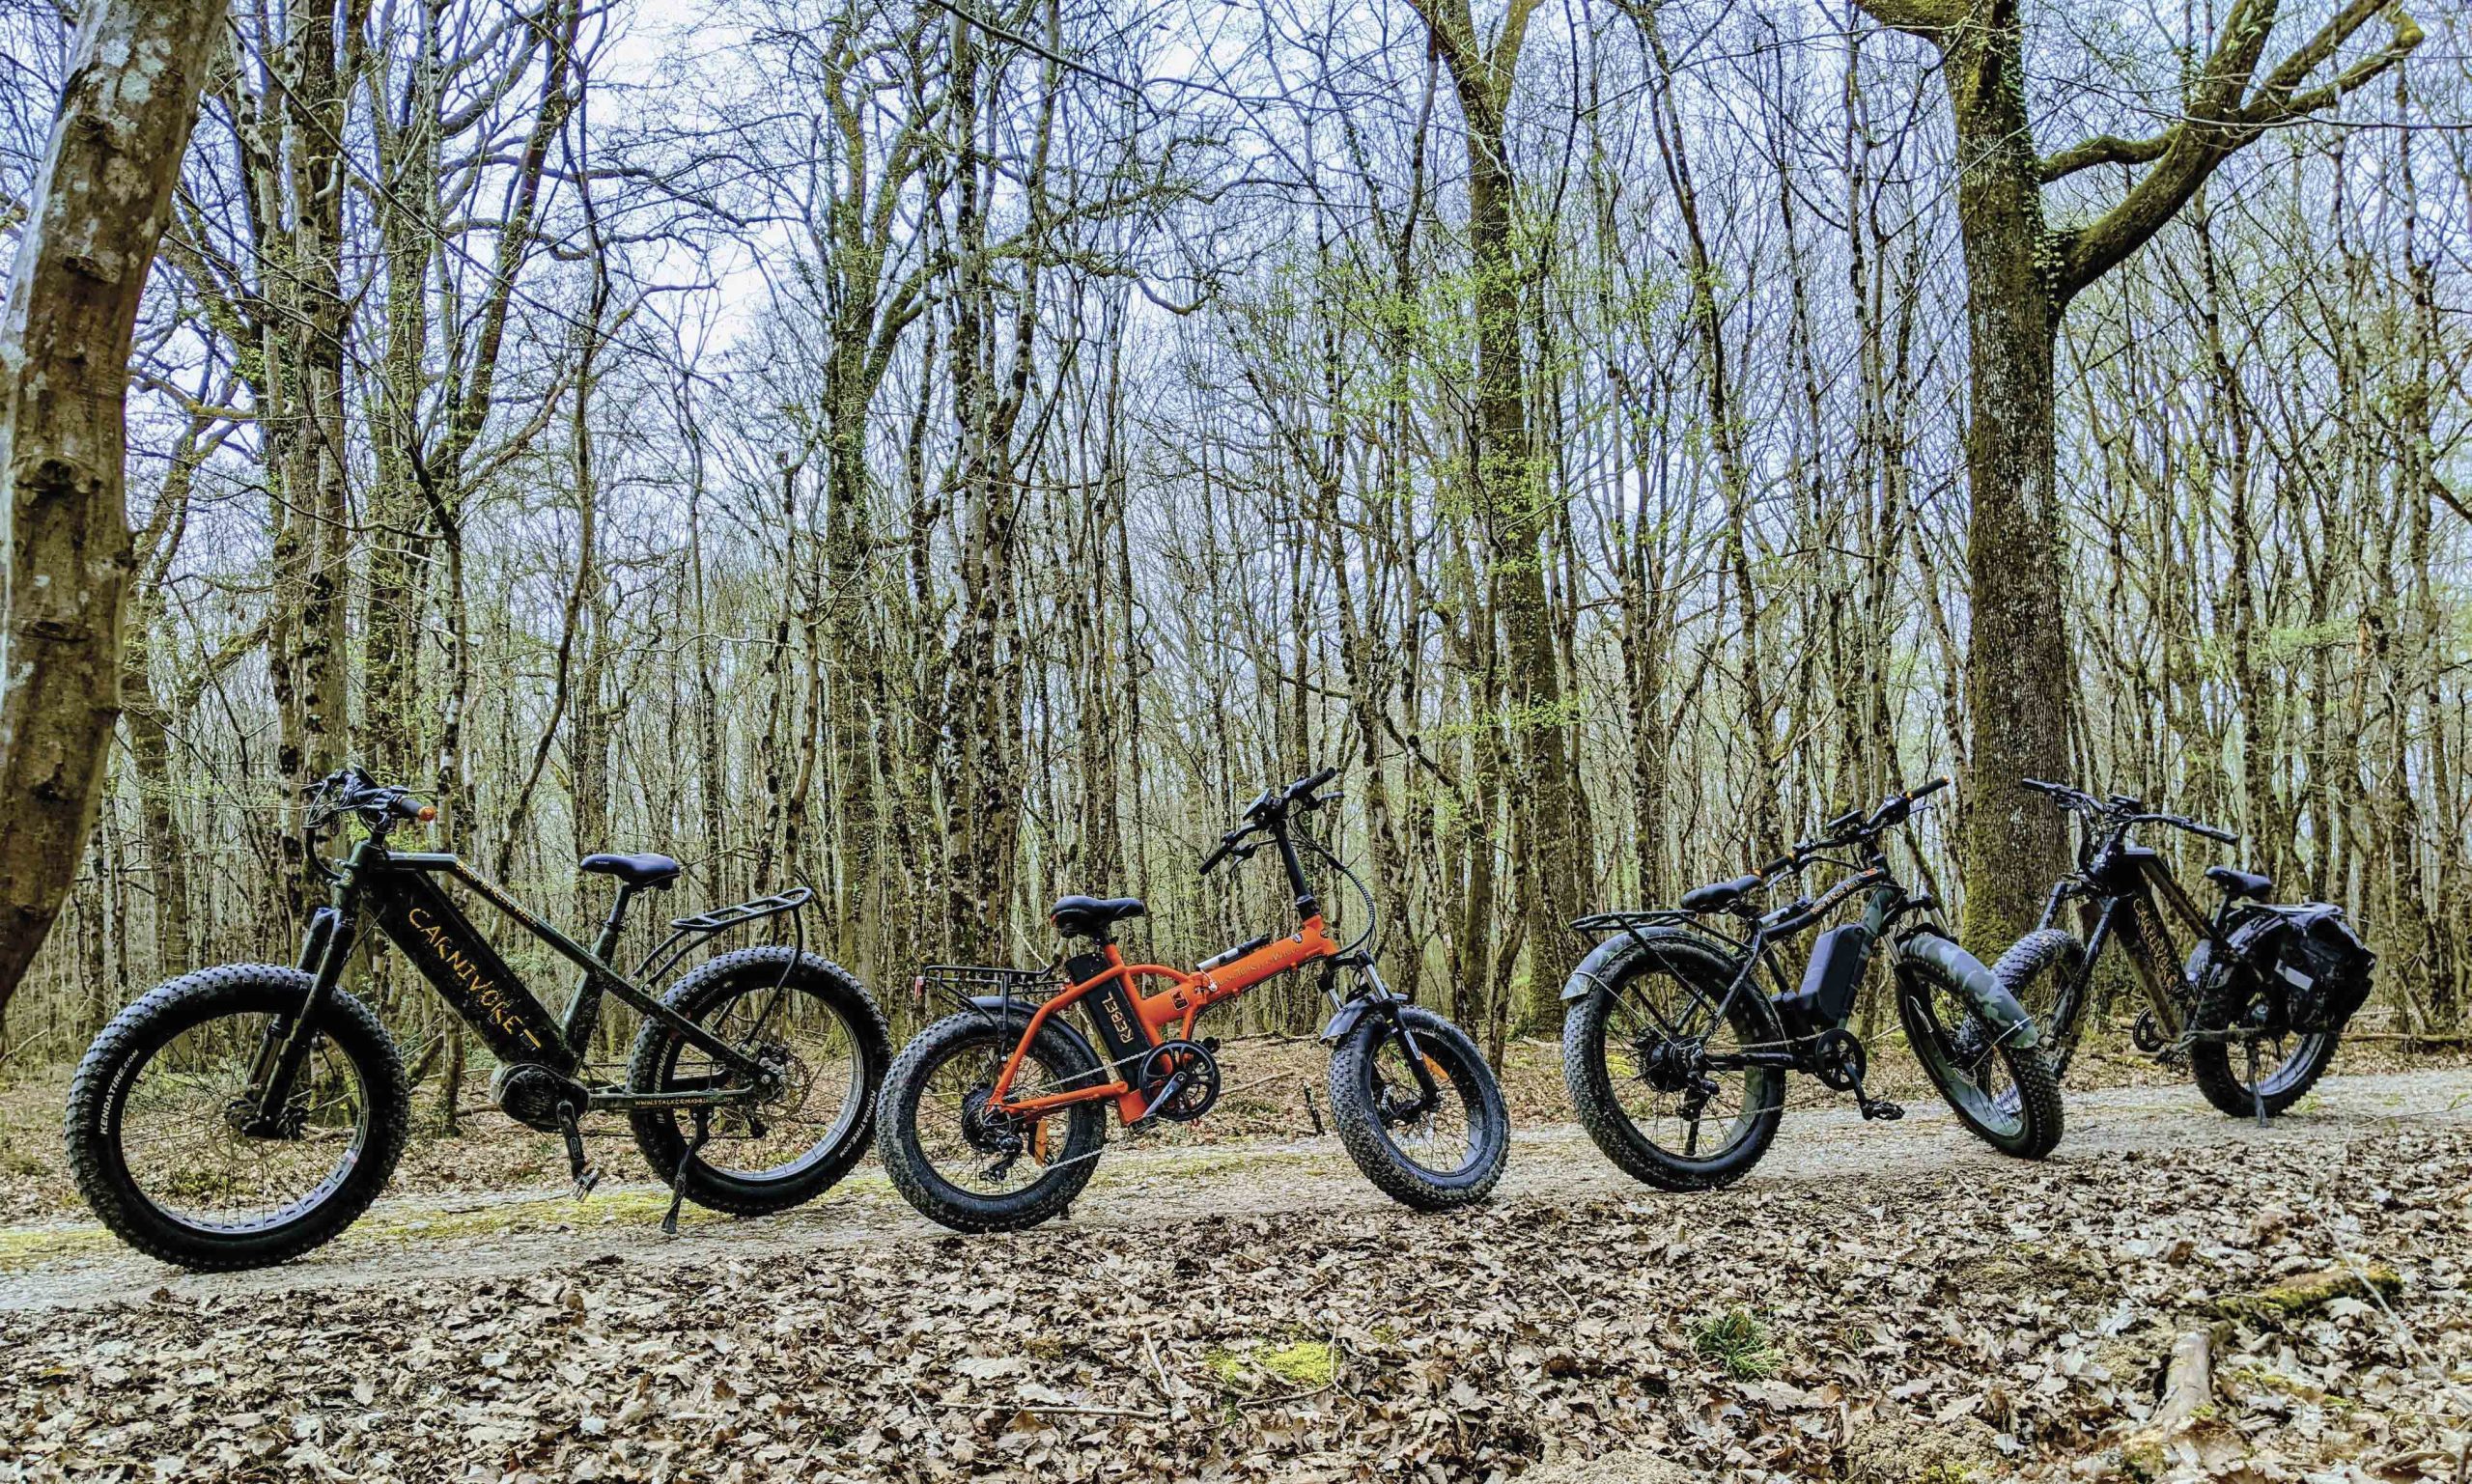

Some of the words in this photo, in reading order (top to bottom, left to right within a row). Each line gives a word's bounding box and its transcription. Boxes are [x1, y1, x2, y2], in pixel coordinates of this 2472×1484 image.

[408, 908, 525, 1035] CARNIVORE
[1101, 991, 1135, 1044] REBEL
[99, 1049, 140, 1135] KENDATIRE.COM
[654, 1037, 673, 1094] GERNAUT
